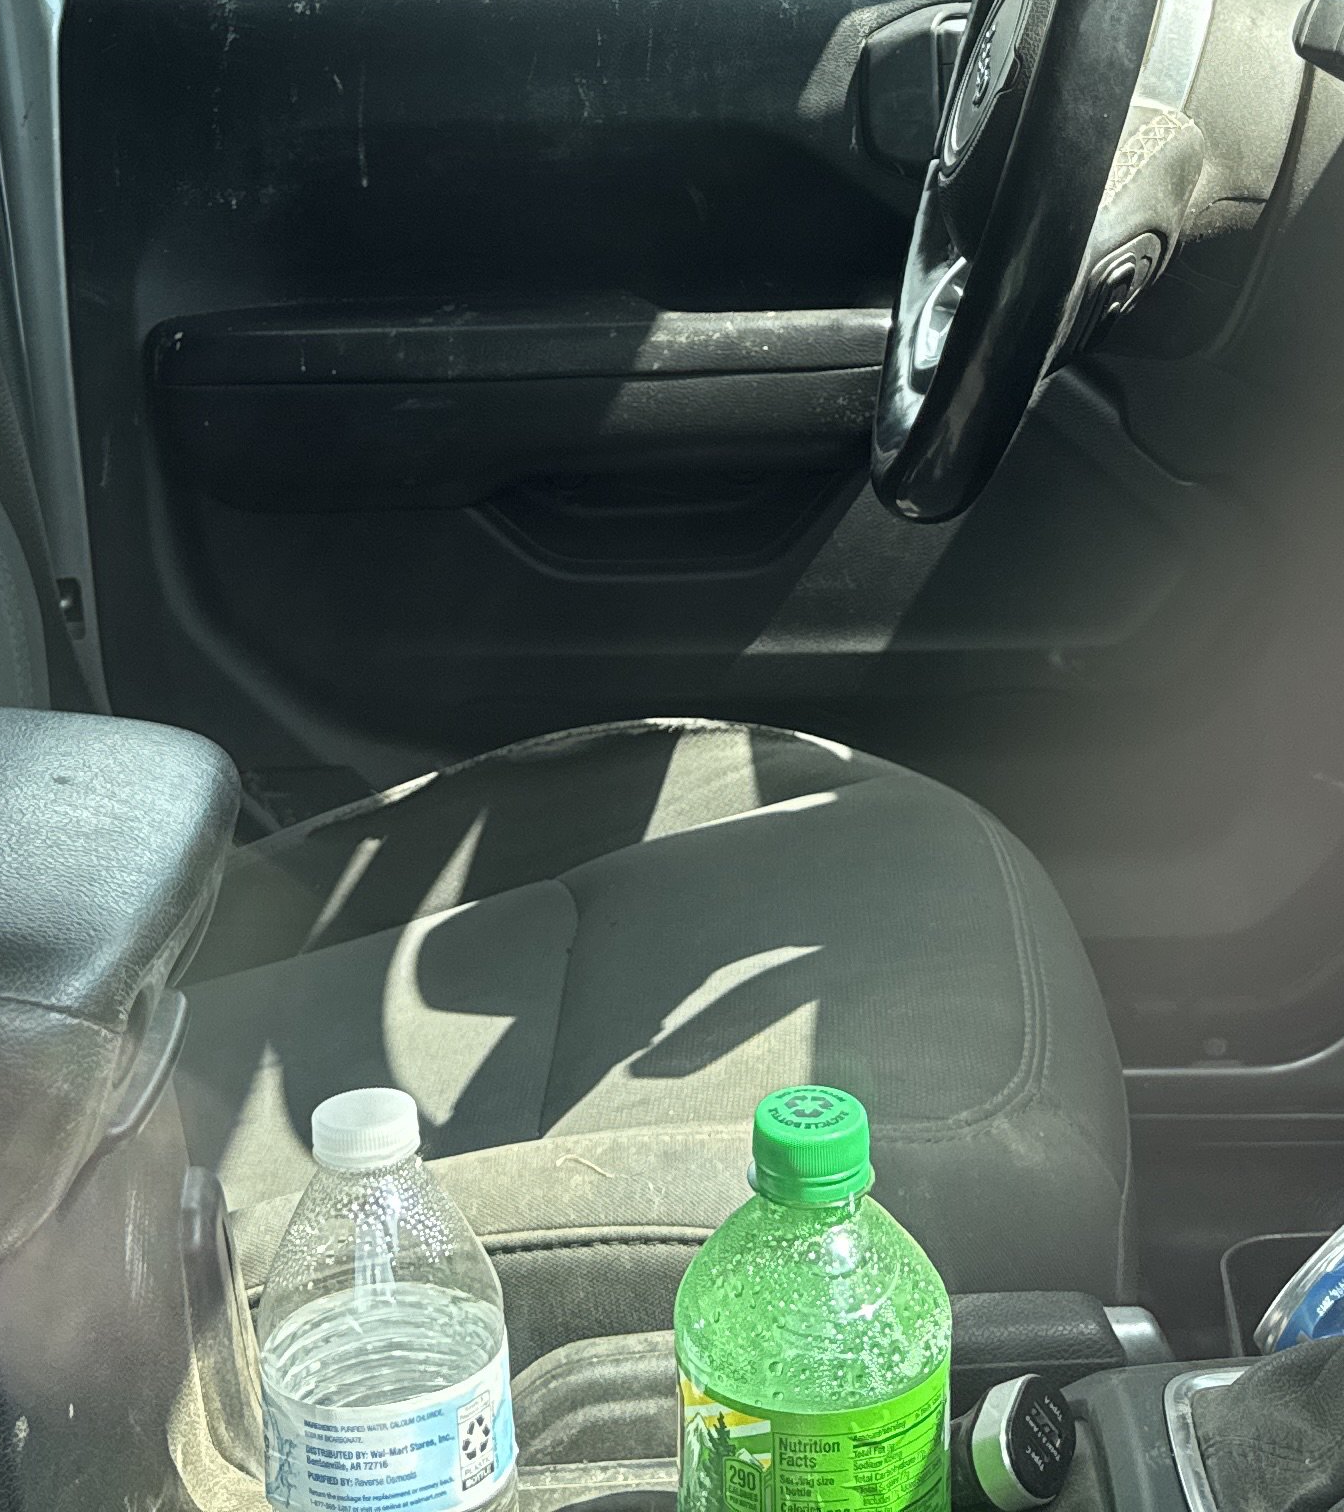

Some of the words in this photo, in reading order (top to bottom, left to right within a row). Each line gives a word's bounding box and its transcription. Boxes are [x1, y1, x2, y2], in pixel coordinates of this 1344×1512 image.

[804, 1110, 850, 1130] RECYCLE
[340, 1424, 366, 1433] PURIFIED
[366, 1422, 389, 1432] WATER,
[389, 1416, 415, 1430] CALCIUM
[305, 1444, 354, 1460] DISTRIBUTED
[355, 1451, 369, 1461] BY:
[370, 1445, 408, 1459] Wal-Mart
[409, 1438, 437, 1452] Stores,
[778, 1436, 841, 1454] Nutrition
[853, 1447, 873, 1458] Total
[873, 1444, 886, 1455] Fat
[350, 1461, 362, 1471] AR
[363, 1460, 389, 1471] 72716
[779, 1451, 817, 1469] Facts
[853, 1460, 883, 1471] Sodium
[307, 1470, 339, 1486] PURIFIED
[340, 1476, 353, 1486] BY:
[354, 1477, 384, 1486] Reverse
[385, 1471, 418, 1485] Osmosis
[466, 1466, 492, 1486] BOTTLE
[729, 1464, 756, 1491] 290
[779, 1473, 815, 1488] Serving
[816, 1476, 835, 1487] size
[853, 1473, 873, 1484] Total
[326, 1492, 337, 1500] the
[337, 1493, 362, 1503] package
[362, 1494, 372, 1502] for
[372, 1489, 411, 1502] replacement
[418, 1482, 439, 1494] money
[785, 1485, 812, 1497] bottle
[381, 1502, 402, 1511] online
[409, 1489, 448, 1506] walmart.com
